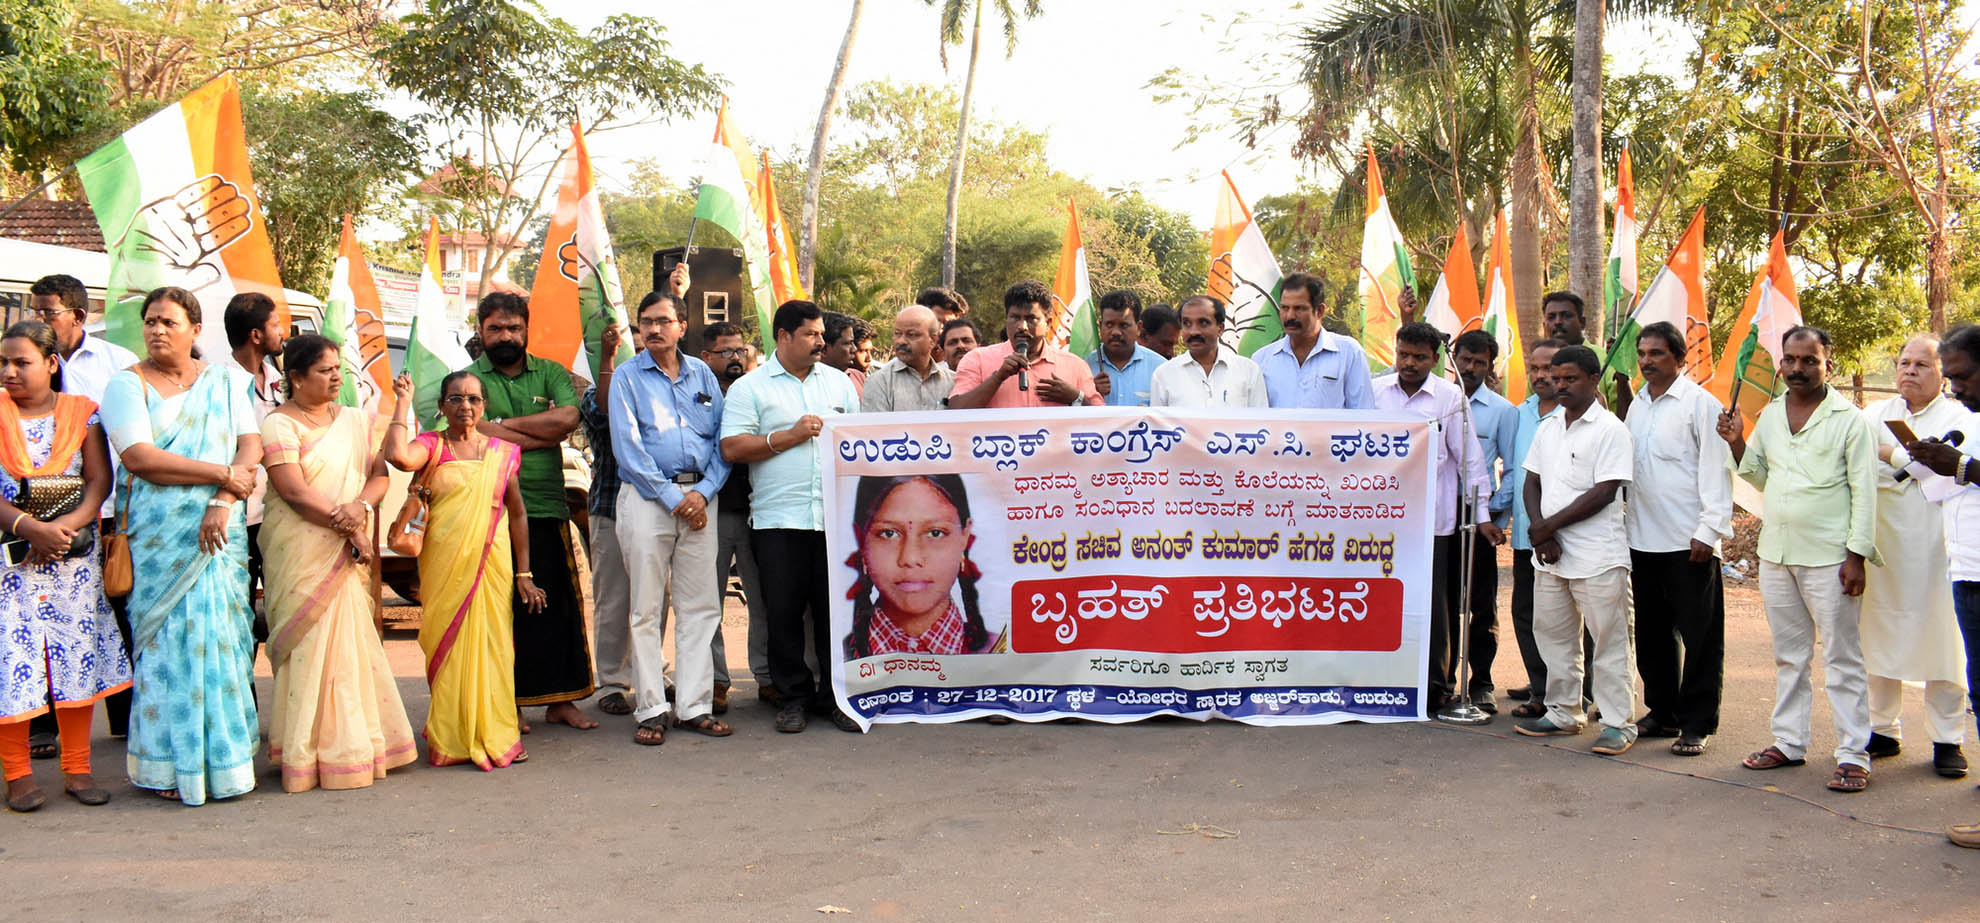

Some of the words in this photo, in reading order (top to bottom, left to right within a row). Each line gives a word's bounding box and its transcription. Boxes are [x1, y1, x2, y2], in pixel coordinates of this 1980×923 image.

[839, 432, 952, 462] ಉಡುಪಿ
[972, 428, 1050, 471] ಬ್ಲಾಕ್
[1071, 421, 1186, 463] ಕಾಂಗ್ರೆಸ್
[1331, 429, 1410, 463] ಘಟಕ
[1014, 471, 1083, 499] ಧಾನಮ್ಮ
[1091, 468, 1169, 496] ಅತ್ಯಾಚಾರ
[1179, 469, 1225, 497] ಮತ್ತು
[1234, 470, 1332, 500] ಕೊಲೆಯನ್ನು
[1340, 473, 1400, 491] ಖಂಡಿಸಿ
[1007, 502, 1064, 521] ಹಾಗೂ
[1075, 499, 1156, 518] ಸಂವಿಧಾನ
[1165, 498, 1255, 517] ಬದಲಾವಣೆ
[1265, 500, 1297, 527] ಬಗ್ಗೆ
[1306, 501, 1406, 520] ಮಾತನಾಡಿದ
[1013, 531, 1068, 572] ಕೇಂದ್ರ
[1075, 527, 1122, 561] ಸಚಿವ
[1131, 528, 1194, 561] ಅನಂತ್
[1201, 528, 1280, 561] ಕುಮಾರ್
[1287, 530, 1336, 562] ಹೆಗಡೆ
[1343, 531, 1396, 577] ವಿರುದ್ಧ
[1031, 580, 1170, 645] ಬೃಹತ್
[1193, 581, 1369, 637] ಪ್ರತಿಭಟನೆ
[884, 657, 947, 681] ಧಾನಮ್ಮ
[1090, 656, 1170, 674] ಸರ್ವರಿಗೂ
[1180, 658, 1235, 676] ಹಾರ್ದಿಕ
[1244, 656, 1289, 682] ಸ್ವಾಗತ
[858, 688, 914, 711] ದಿನಾಂಕ
[937, 688, 1058, 703] 27-12-2017
[1066, 687, 1096, 711] ಸ್ಥಳ
[1354, 689, 1409, 705] ಉಡುಪಿ
